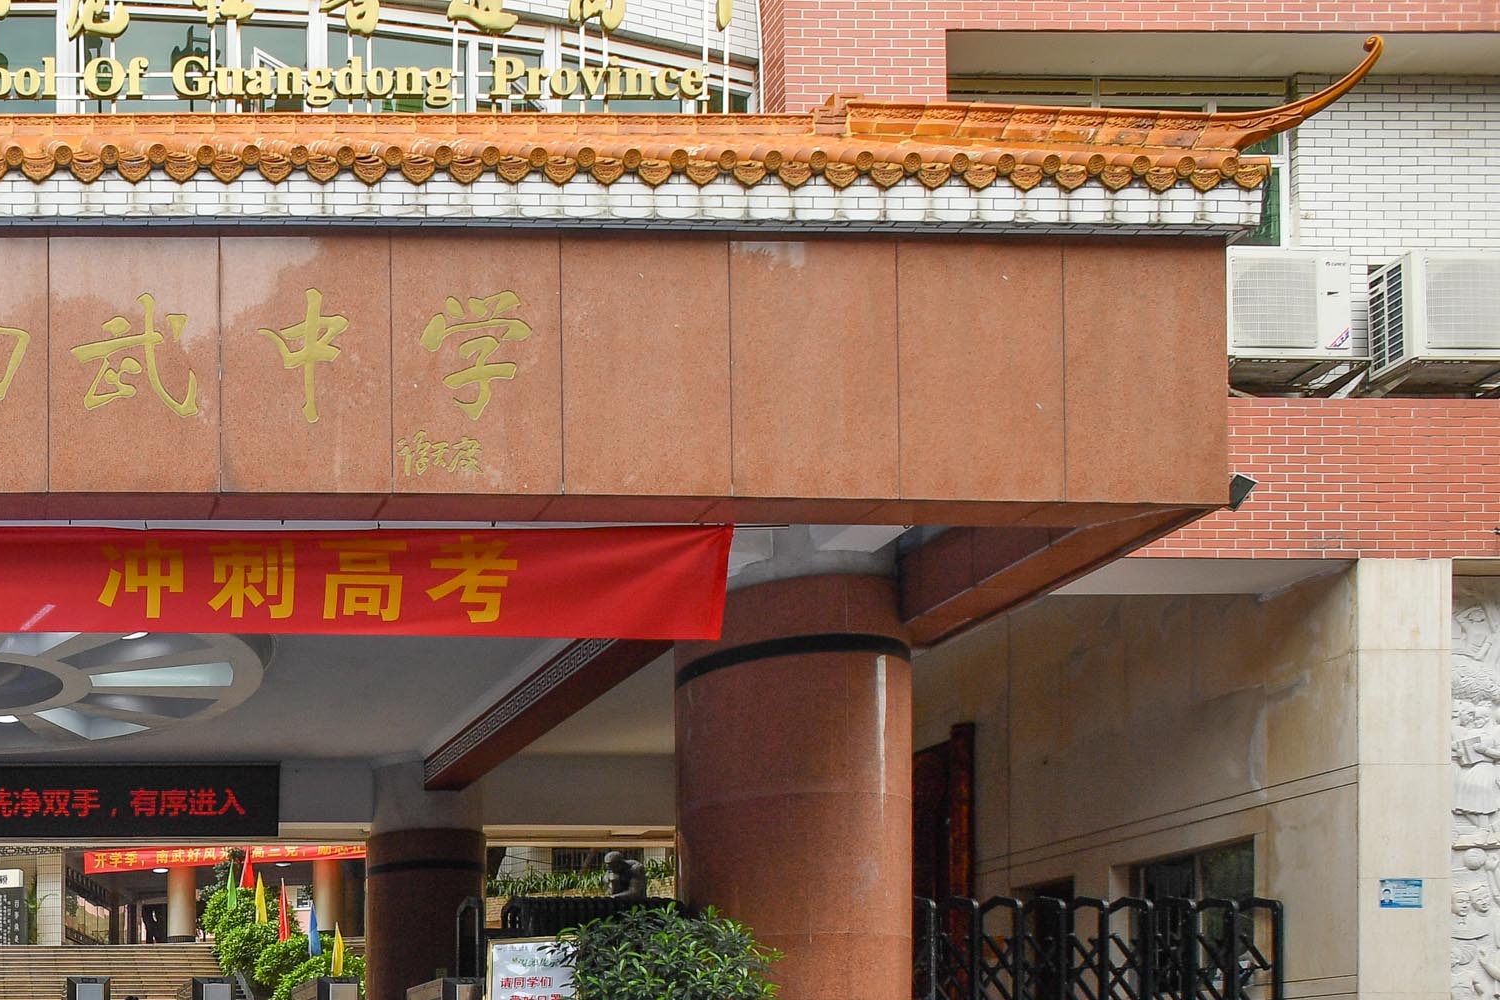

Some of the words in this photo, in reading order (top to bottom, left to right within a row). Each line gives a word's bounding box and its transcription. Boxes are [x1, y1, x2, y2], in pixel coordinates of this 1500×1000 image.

[83, 57, 149, 98] Of
[172, 56, 453, 107] Guangdong
[490, 56, 709, 99] Province
[97, 535, 520, 623] 冲刺高考
[500, 976, 554, 989] 请同学们
